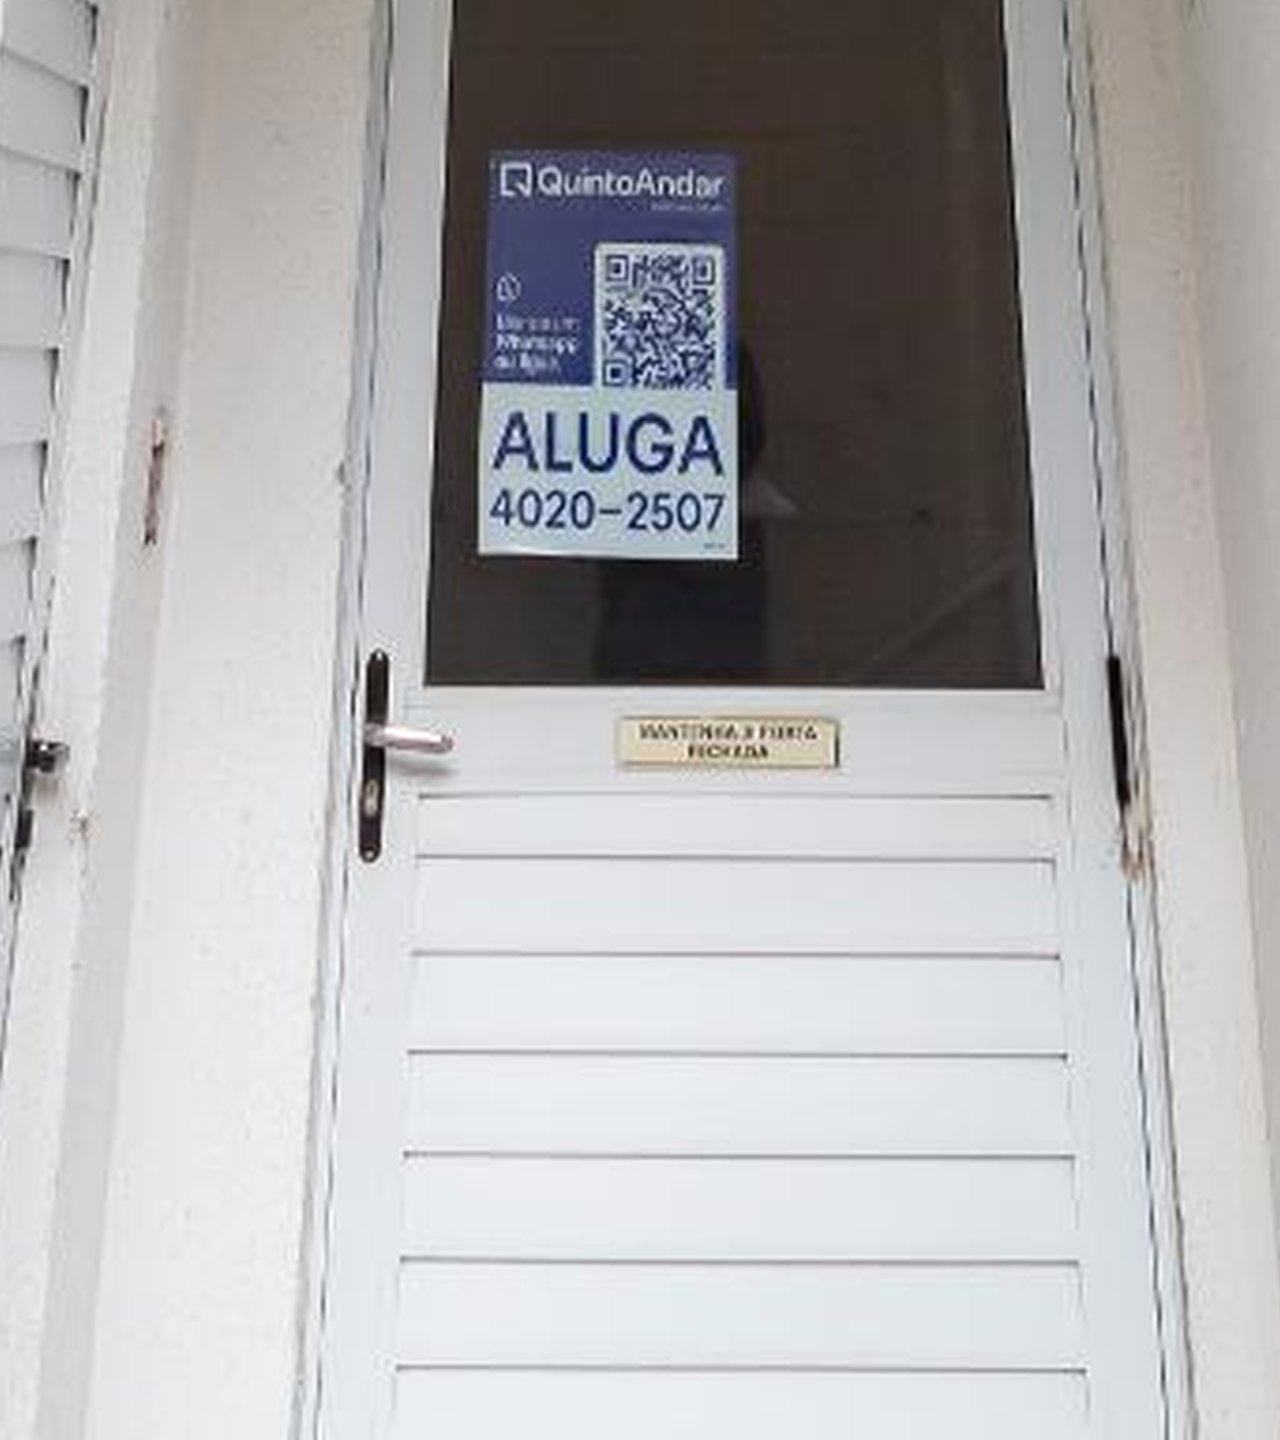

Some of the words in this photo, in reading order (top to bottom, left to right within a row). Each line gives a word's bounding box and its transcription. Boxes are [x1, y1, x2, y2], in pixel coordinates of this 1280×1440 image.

[537, 166, 725, 196] QuintoAndar
[492, 411, 724, 476] ALUGA
[489, 488, 726, 533] 4020-2507
